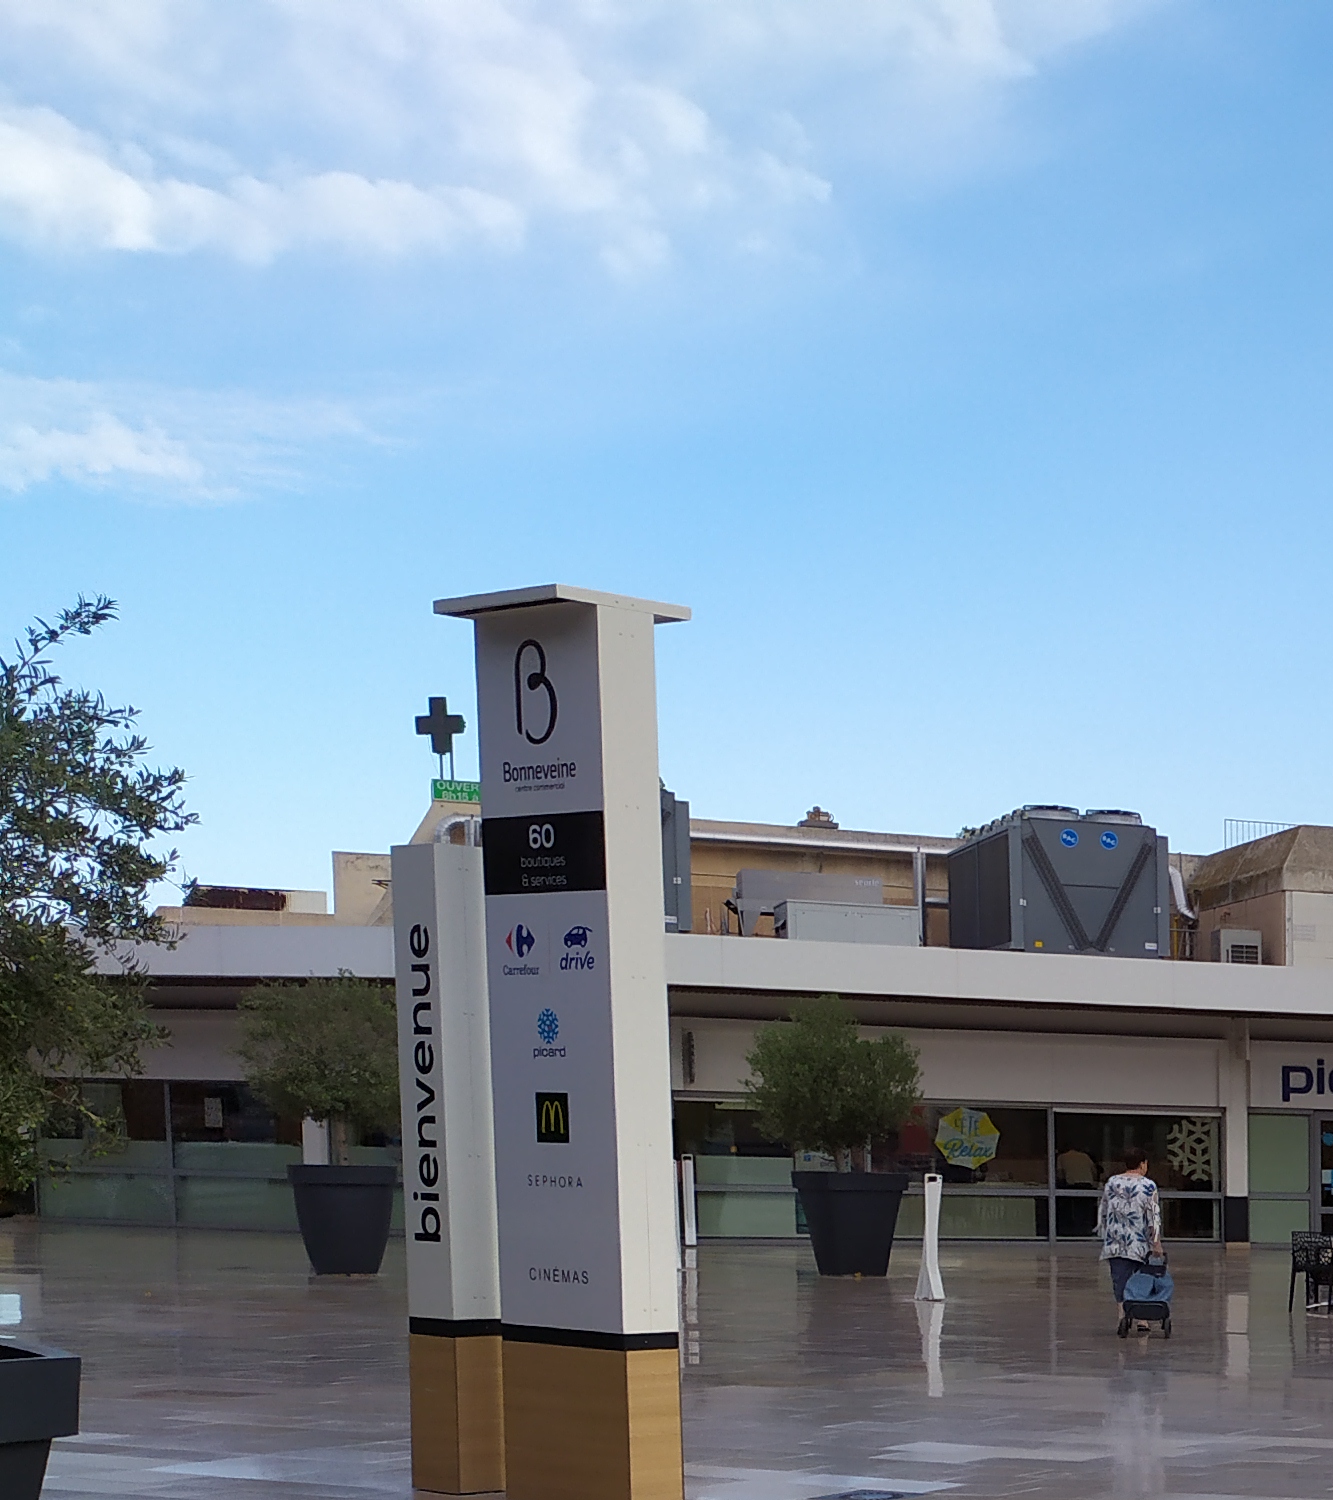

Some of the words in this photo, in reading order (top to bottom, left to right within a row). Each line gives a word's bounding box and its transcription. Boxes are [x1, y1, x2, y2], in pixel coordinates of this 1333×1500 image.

[503, 757, 576, 782] Bonneveine
[436, 780, 479, 792] OUVER
[528, 823, 555, 849] 60
[520, 855, 566, 868] boutiques
[522, 874, 529, 886] &
[531, 873, 567, 886] services
[560, 950, 595, 970] drive
[502, 964, 540, 976] Carrefour
[533, 1046, 566, 1059] picard
[409, 923, 442, 1243] bienvenue
[527, 1174, 583, 1188] SEPHORA
[528, 1266, 590, 1285] CINÉMAS
